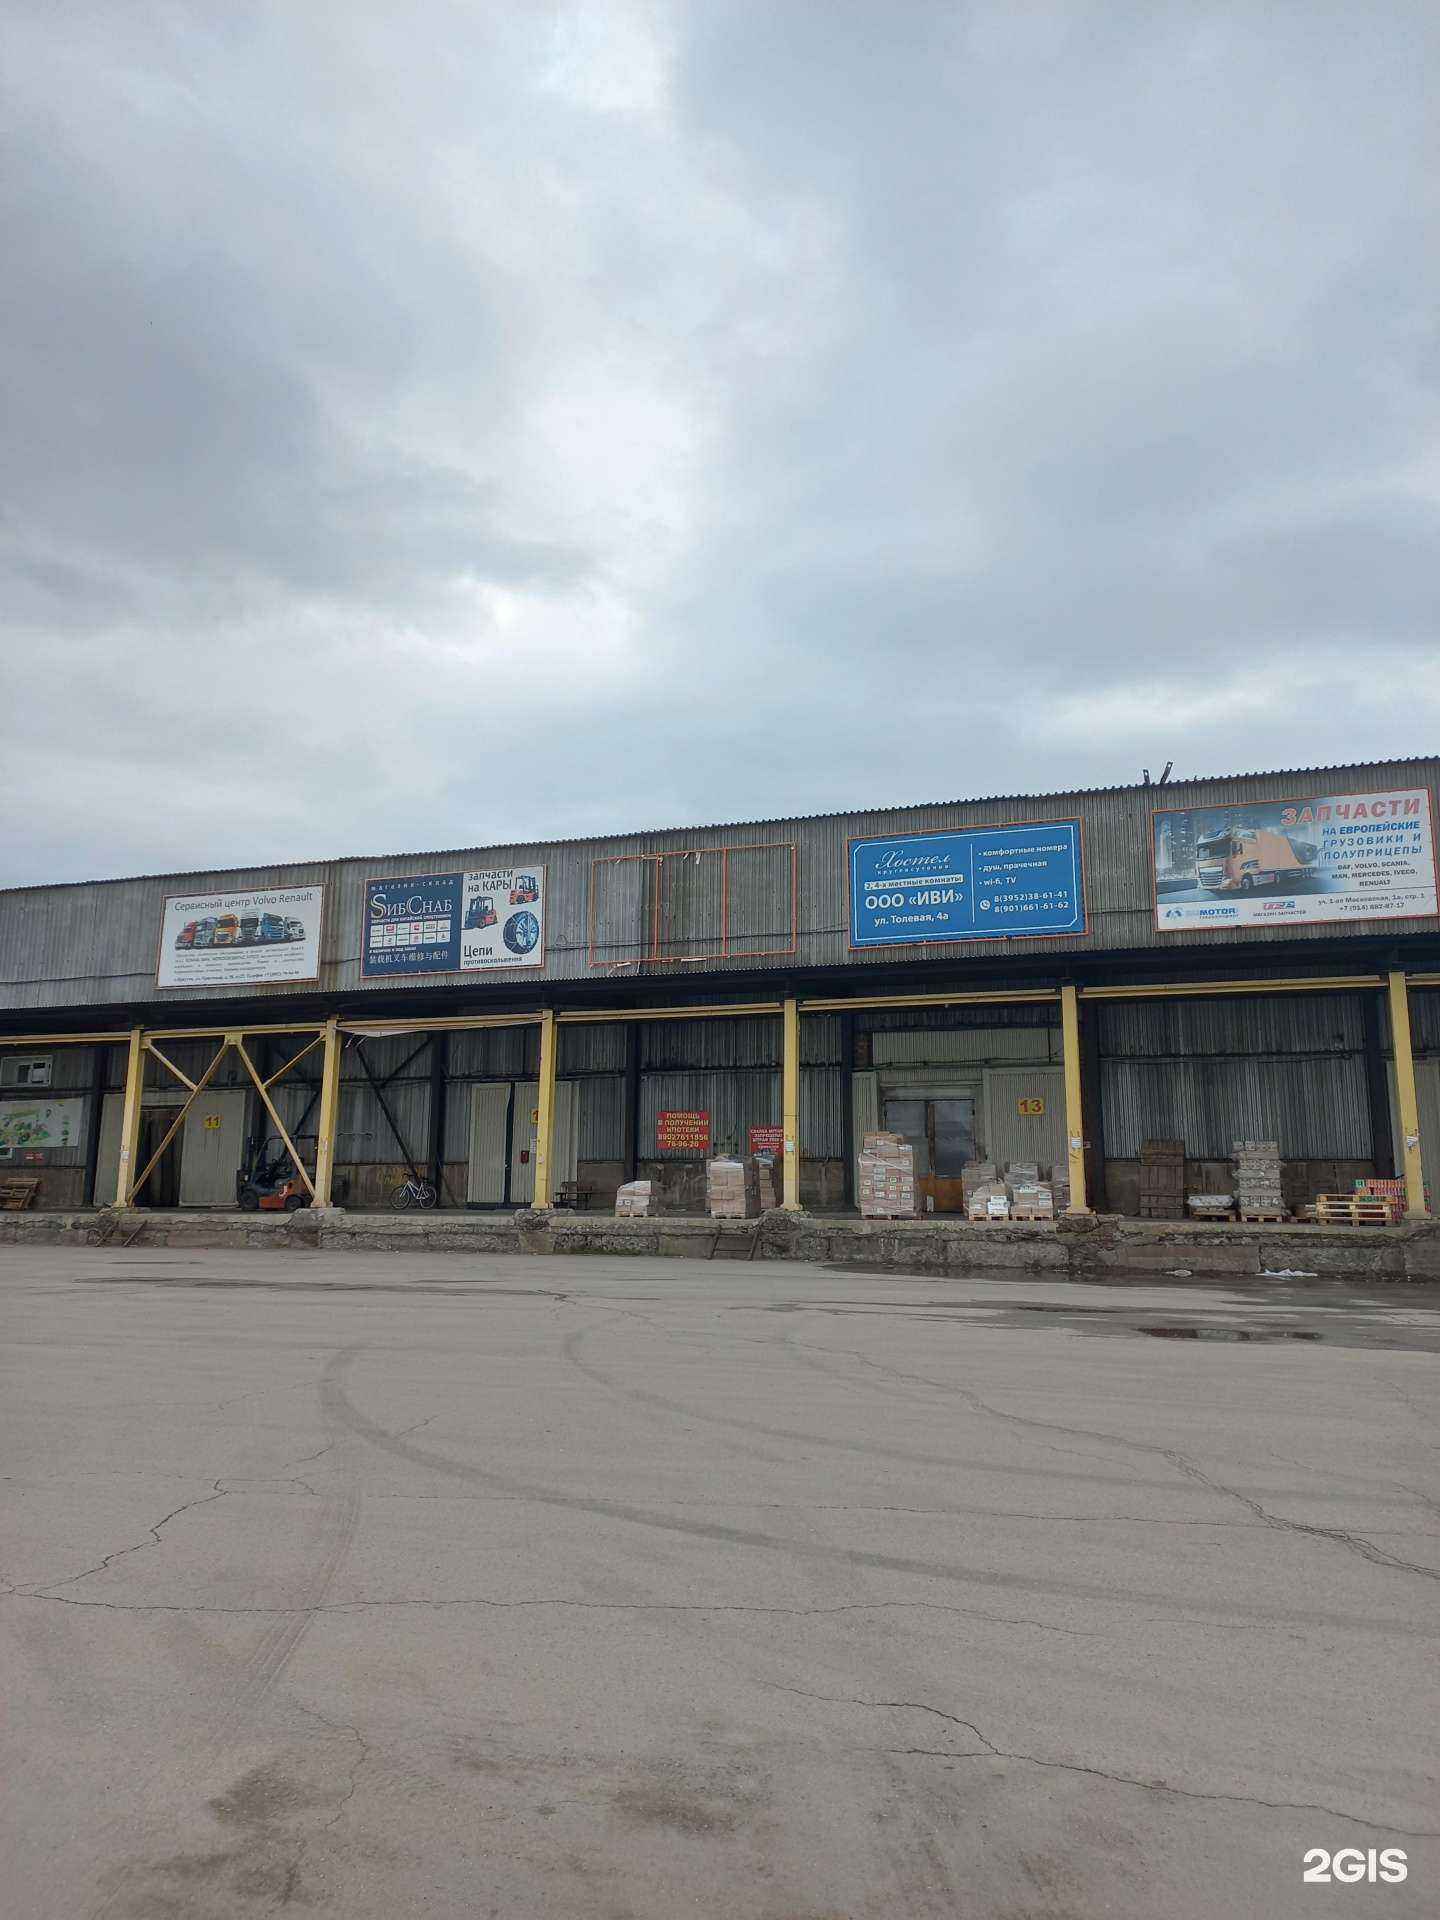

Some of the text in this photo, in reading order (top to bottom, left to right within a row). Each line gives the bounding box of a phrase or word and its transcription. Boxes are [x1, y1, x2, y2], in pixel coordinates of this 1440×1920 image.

[1281, 799, 1421, 826] ЗАПЧАСТИ
[1322, 821, 1420, 836] НА ЕВРОПЕЙСКИЕ
[1323, 833, 1421, 848] ГРУЗОВИКИ И
[983, 844, 1068, 857] комфортные номера
[1324, 845, 1422, 860] ПОЛУПРИЦЕПЫ
[875, 849, 951, 868] Хостел
[983, 861, 1047, 873] душ, прачечная
[468, 870, 513, 881] запчасти
[468, 880, 512, 893] на КАРЫ
[175, 892, 313, 911] Сервисный центр Volvo Renault
[865, 889, 963, 909] ООО «ИВИ»
[874, 911, 949, 927] ул. Толевая, 4а
[464, 945, 493, 958] Цепи
[1020, 1099, 1042, 1112] 13
[208, 1116, 219, 1127] 11
